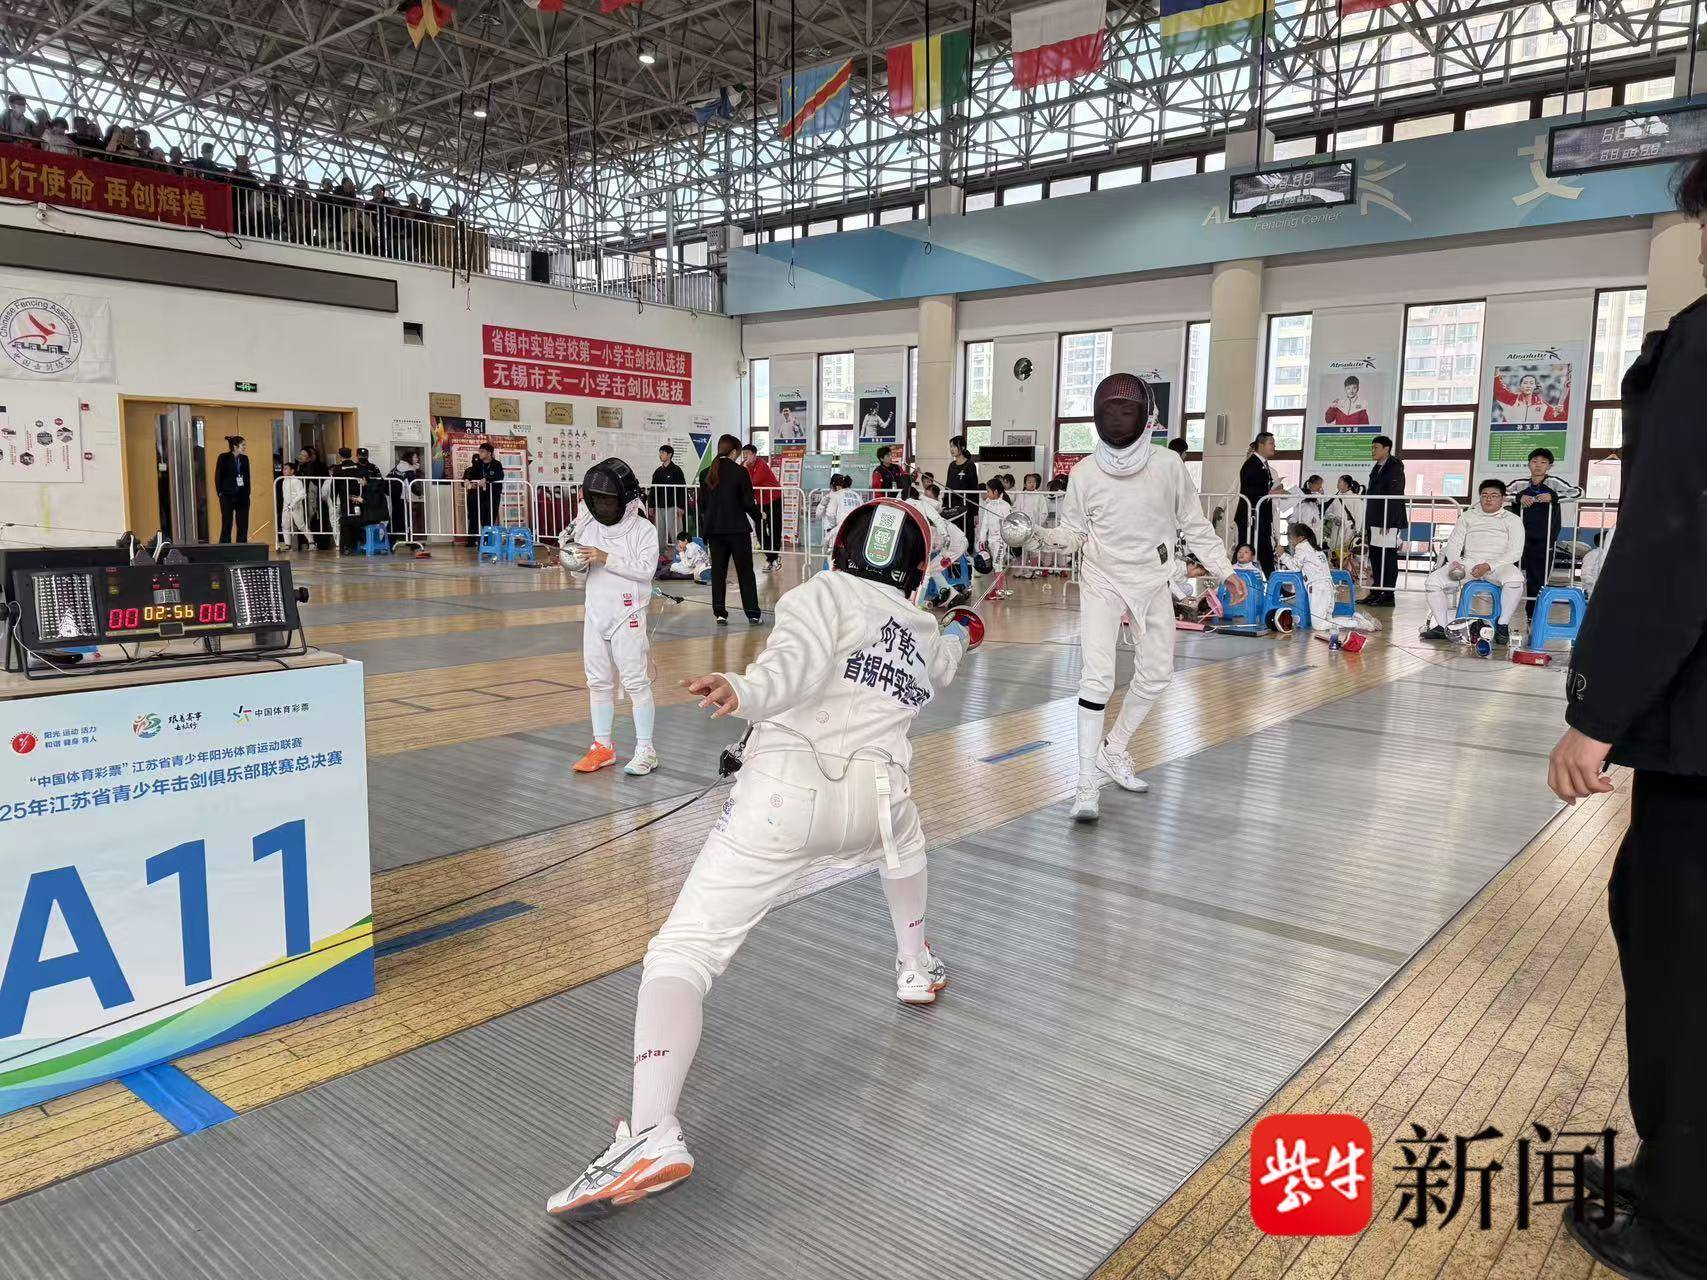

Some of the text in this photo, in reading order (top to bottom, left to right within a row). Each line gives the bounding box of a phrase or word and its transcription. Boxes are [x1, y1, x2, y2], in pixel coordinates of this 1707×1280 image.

[0, 157, 207, 220] 行使命 再创辉煌
[1254, 216, 1299, 231] Fencing
[1302, 212, 1342, 225] Center
[0, 299, 79, 343] Chinese Fencing Association
[493, 363, 684, 402] 无锡市天一小学击剑队选拔
[109, 602, 227, 630] 00 02:56 00
[254, 703, 310, 718] 中国体育彩票
[44, 730, 61, 739] 阳光
[62, 728, 79, 737] 运动
[82, 735, 97, 744] 育人
[0, 819, 311, 1039] A11
